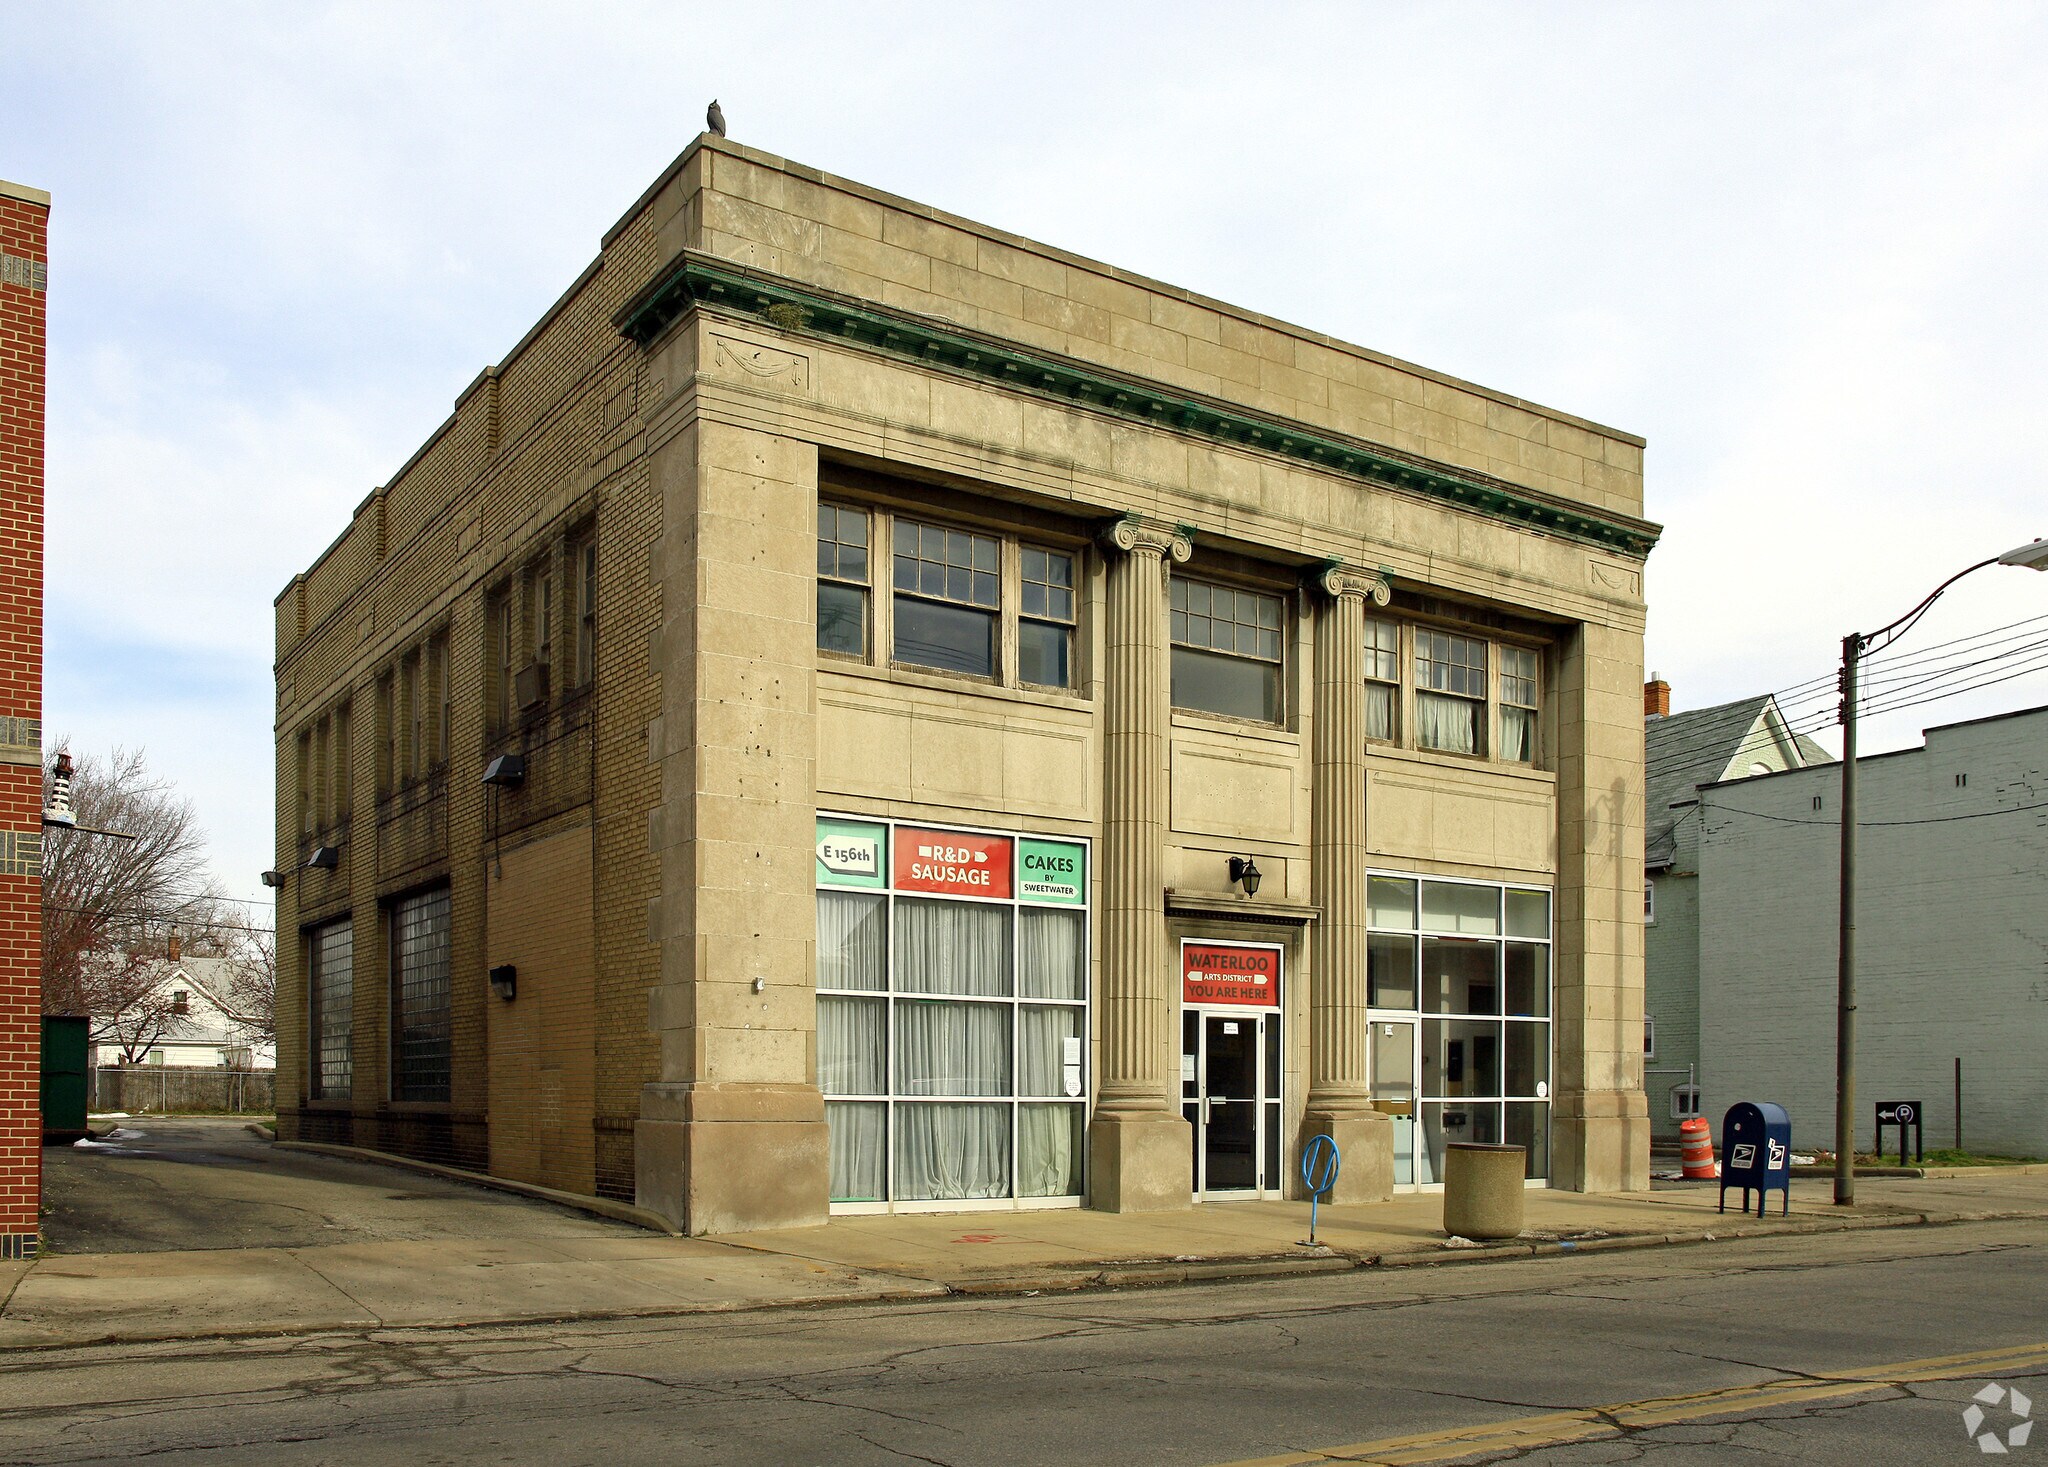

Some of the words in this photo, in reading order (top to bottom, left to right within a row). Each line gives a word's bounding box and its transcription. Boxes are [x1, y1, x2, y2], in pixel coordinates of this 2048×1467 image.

[823, 845, 832, 858] E
[834, 847, 870, 863] 156th
[933, 845, 971, 864] R&D
[1024, 854, 1074, 873] CAKES
[911, 862, 991, 886] SAUSAGE
[1044, 874, 1055, 882] BY
[1024, 883, 1074, 895] SWEETWATER
[1188, 953, 1269, 971] WATERLOO
[1203, 973, 1222, 981] ARTS
[1222, 974, 1253, 983] DISTRICT
[1188, 985, 1214, 997] YOU
[1216, 986, 1238, 998] ARE
[1240, 987, 1268, 999] HERE
